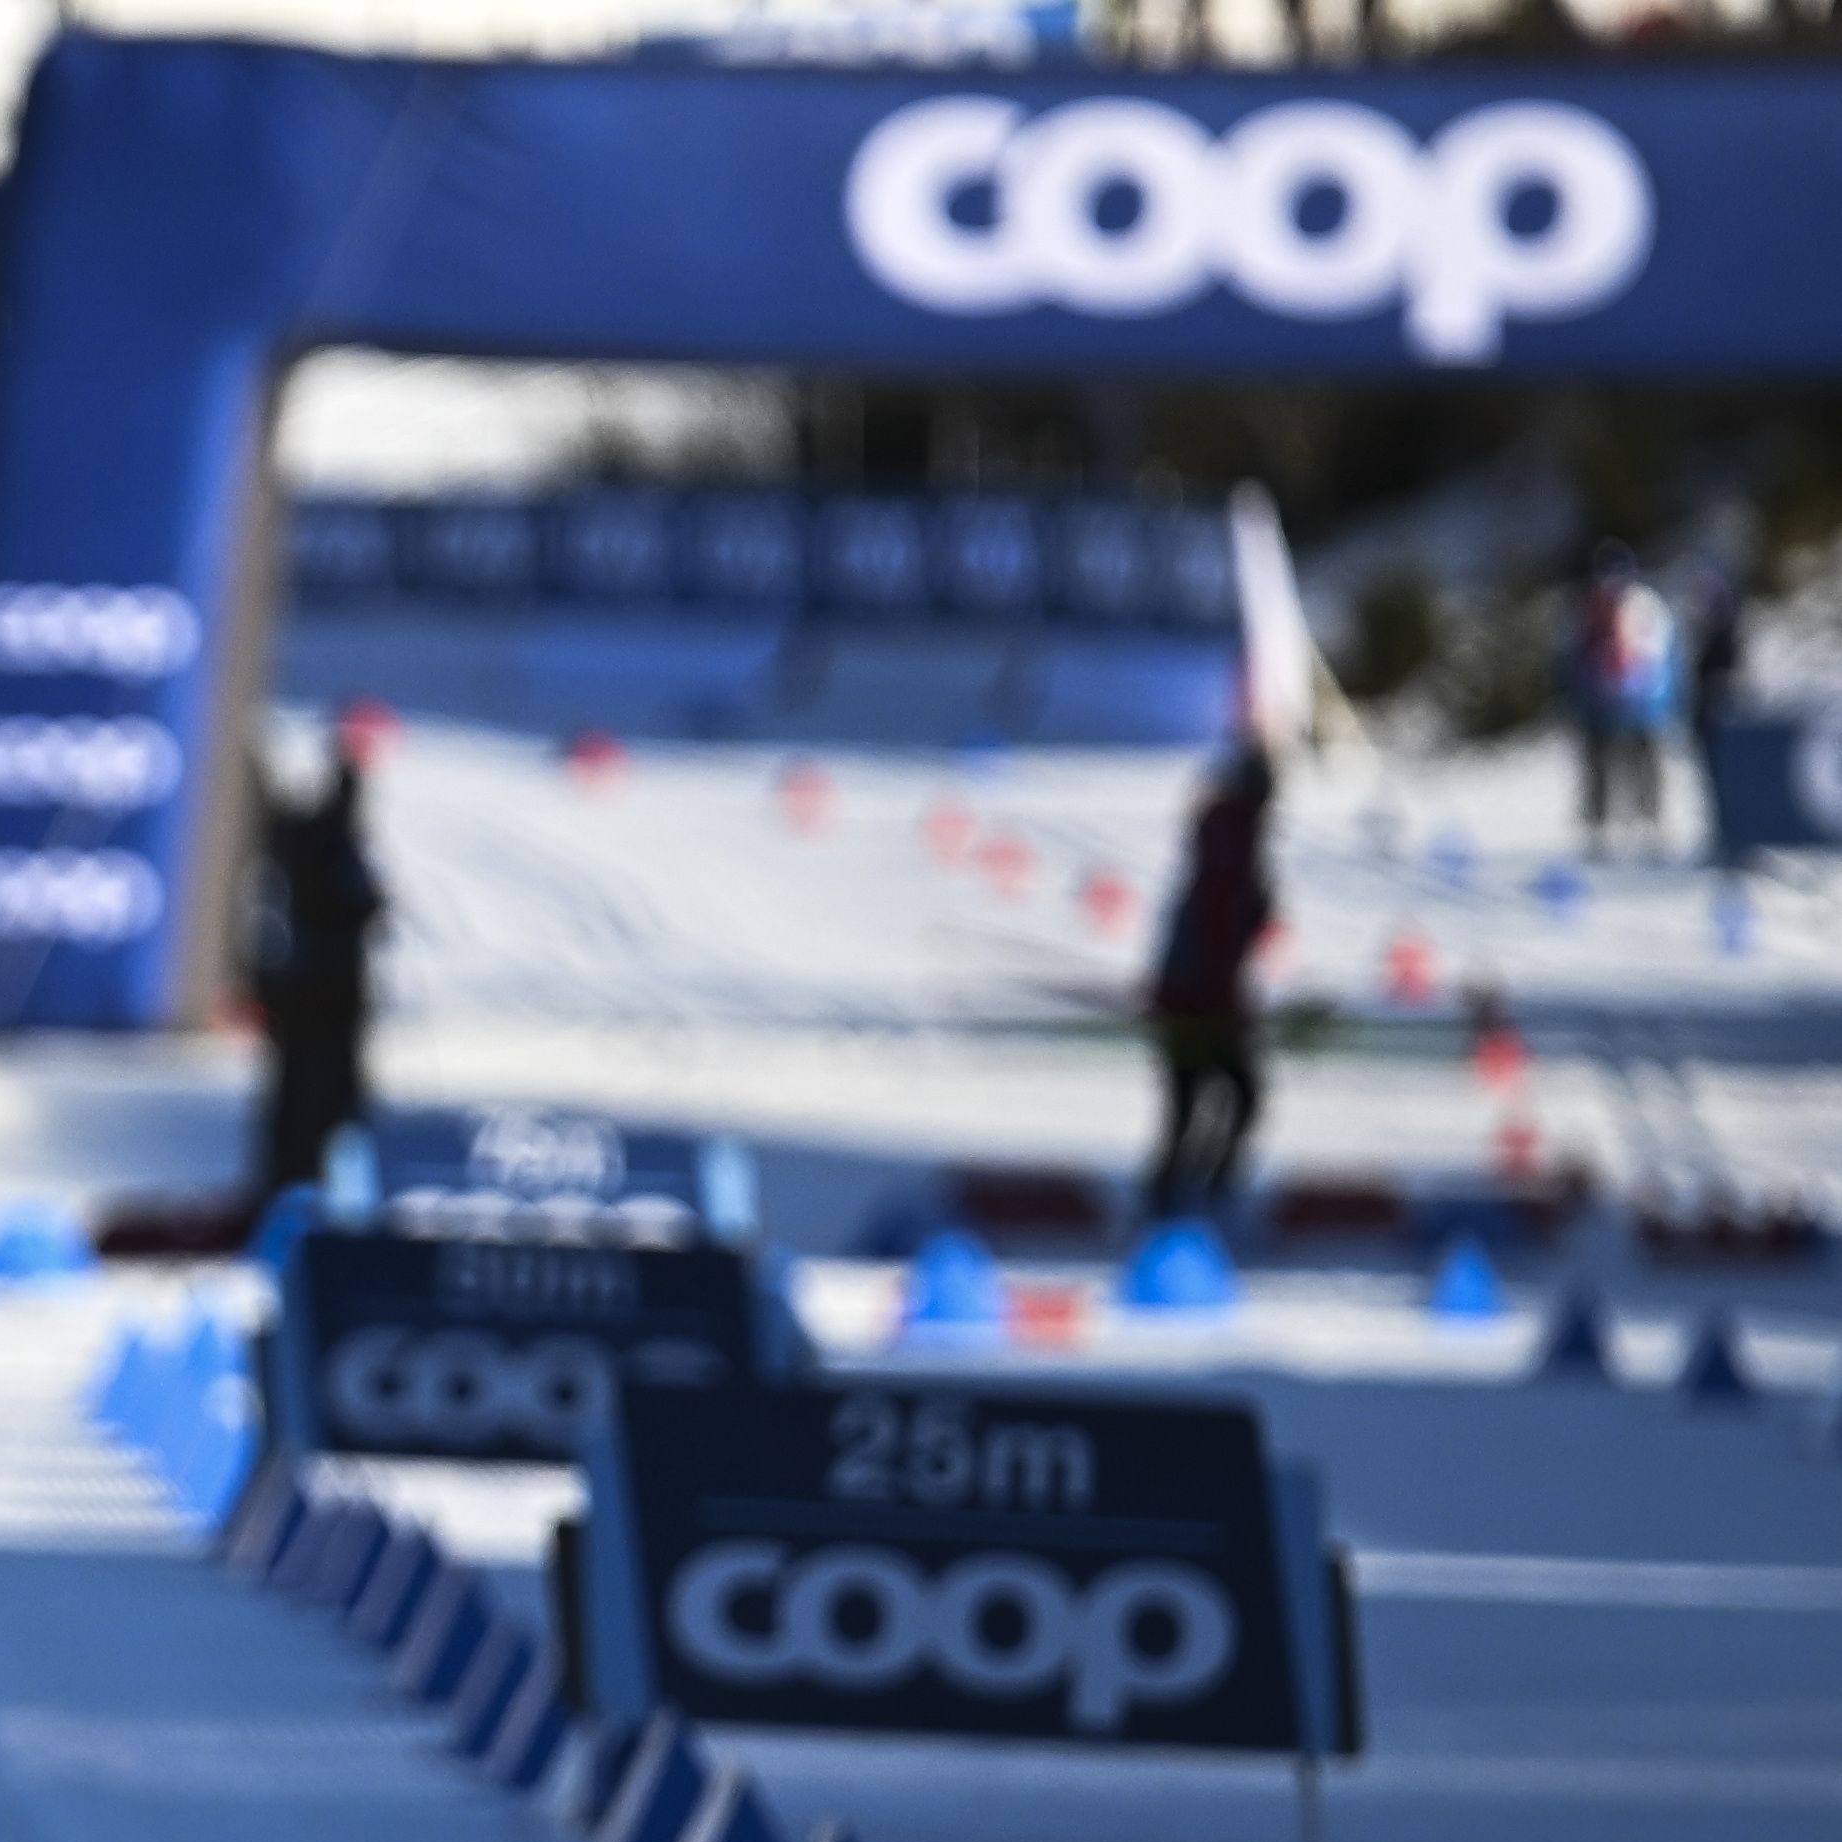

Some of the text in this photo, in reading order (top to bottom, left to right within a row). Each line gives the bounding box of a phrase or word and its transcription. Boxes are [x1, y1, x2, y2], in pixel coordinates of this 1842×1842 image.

[845, 96, 1651, 363] coop
[825, 1400, 1094, 1510] 25m
[666, 1538, 1235, 1734] coop
